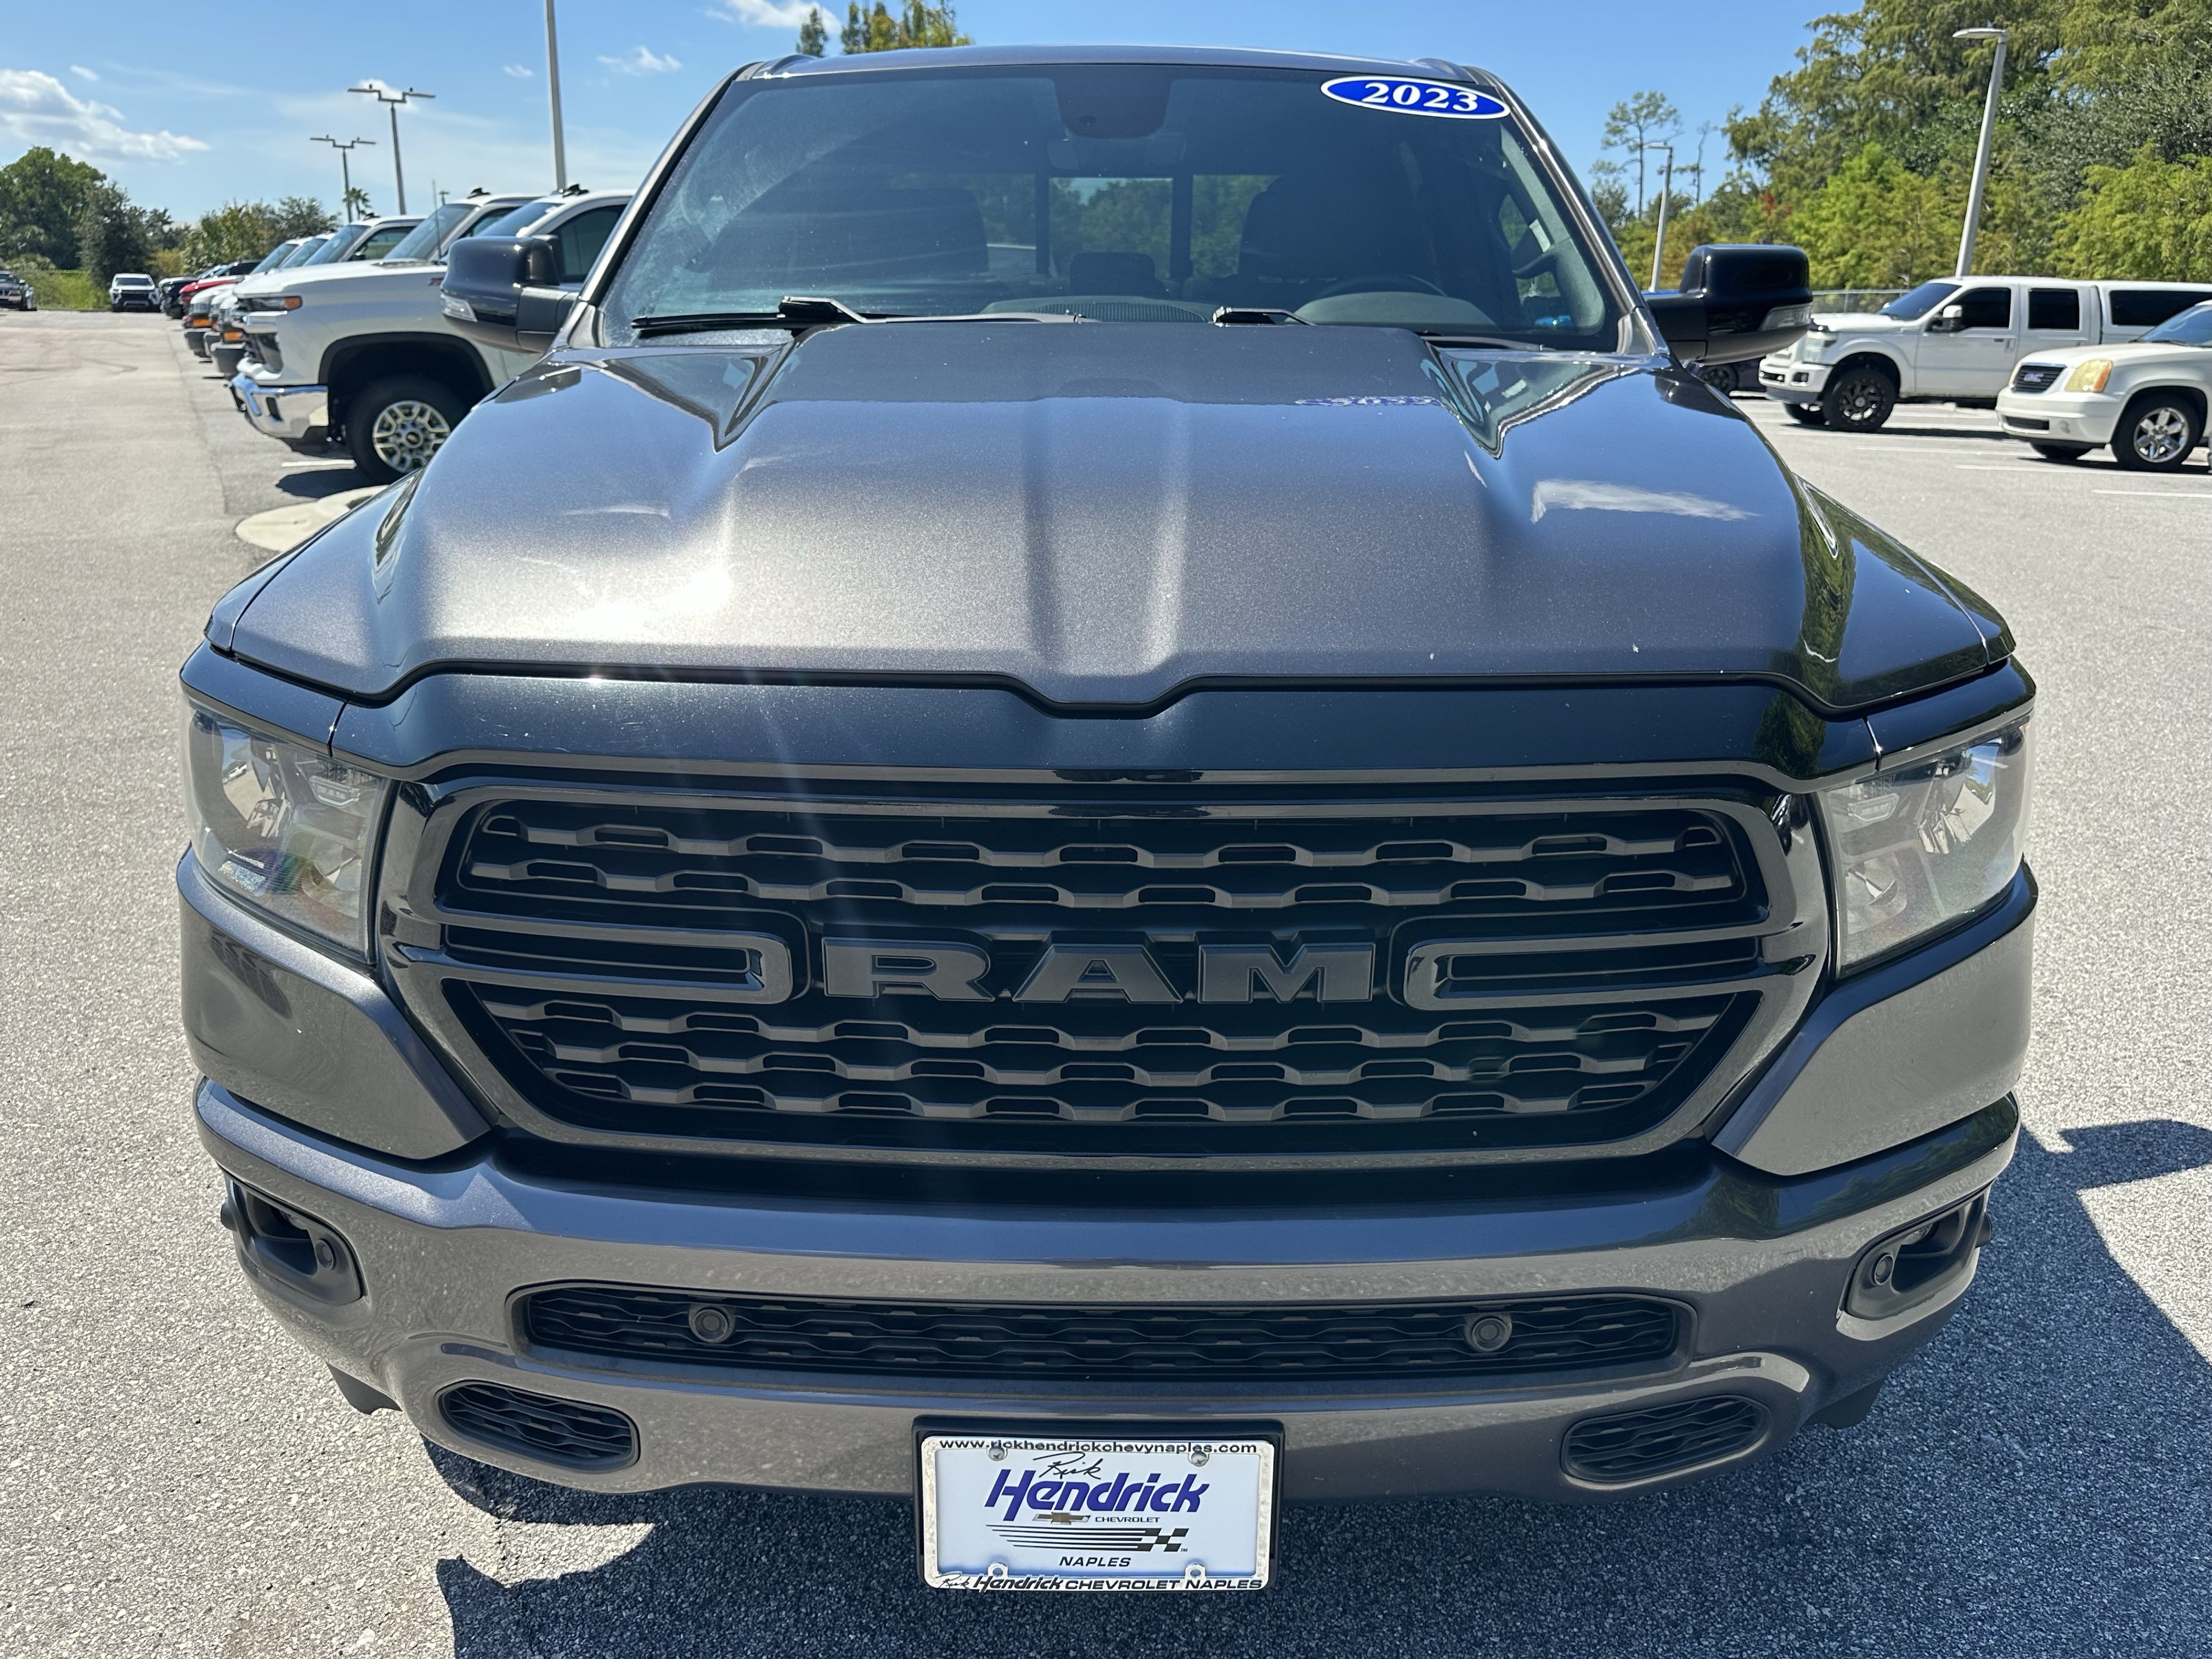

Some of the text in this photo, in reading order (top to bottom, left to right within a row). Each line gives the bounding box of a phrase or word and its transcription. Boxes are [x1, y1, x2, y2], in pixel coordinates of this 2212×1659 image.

[1361, 82, 1478, 111] 2023
[821, 936, 1376, 1004] RAM
[939, 1440, 1257, 1454] www.rickhendrickchevynaples.com
[984, 1469, 1210, 1522] Hendrick
[1059, 1556, 1131, 1567] NAPLES
[972, 1575, 1065, 1593] Hendrick
[1064, 1579, 1181, 1590] CHEVROLET
[1185, 1578, 1262, 1590] NAPLES
